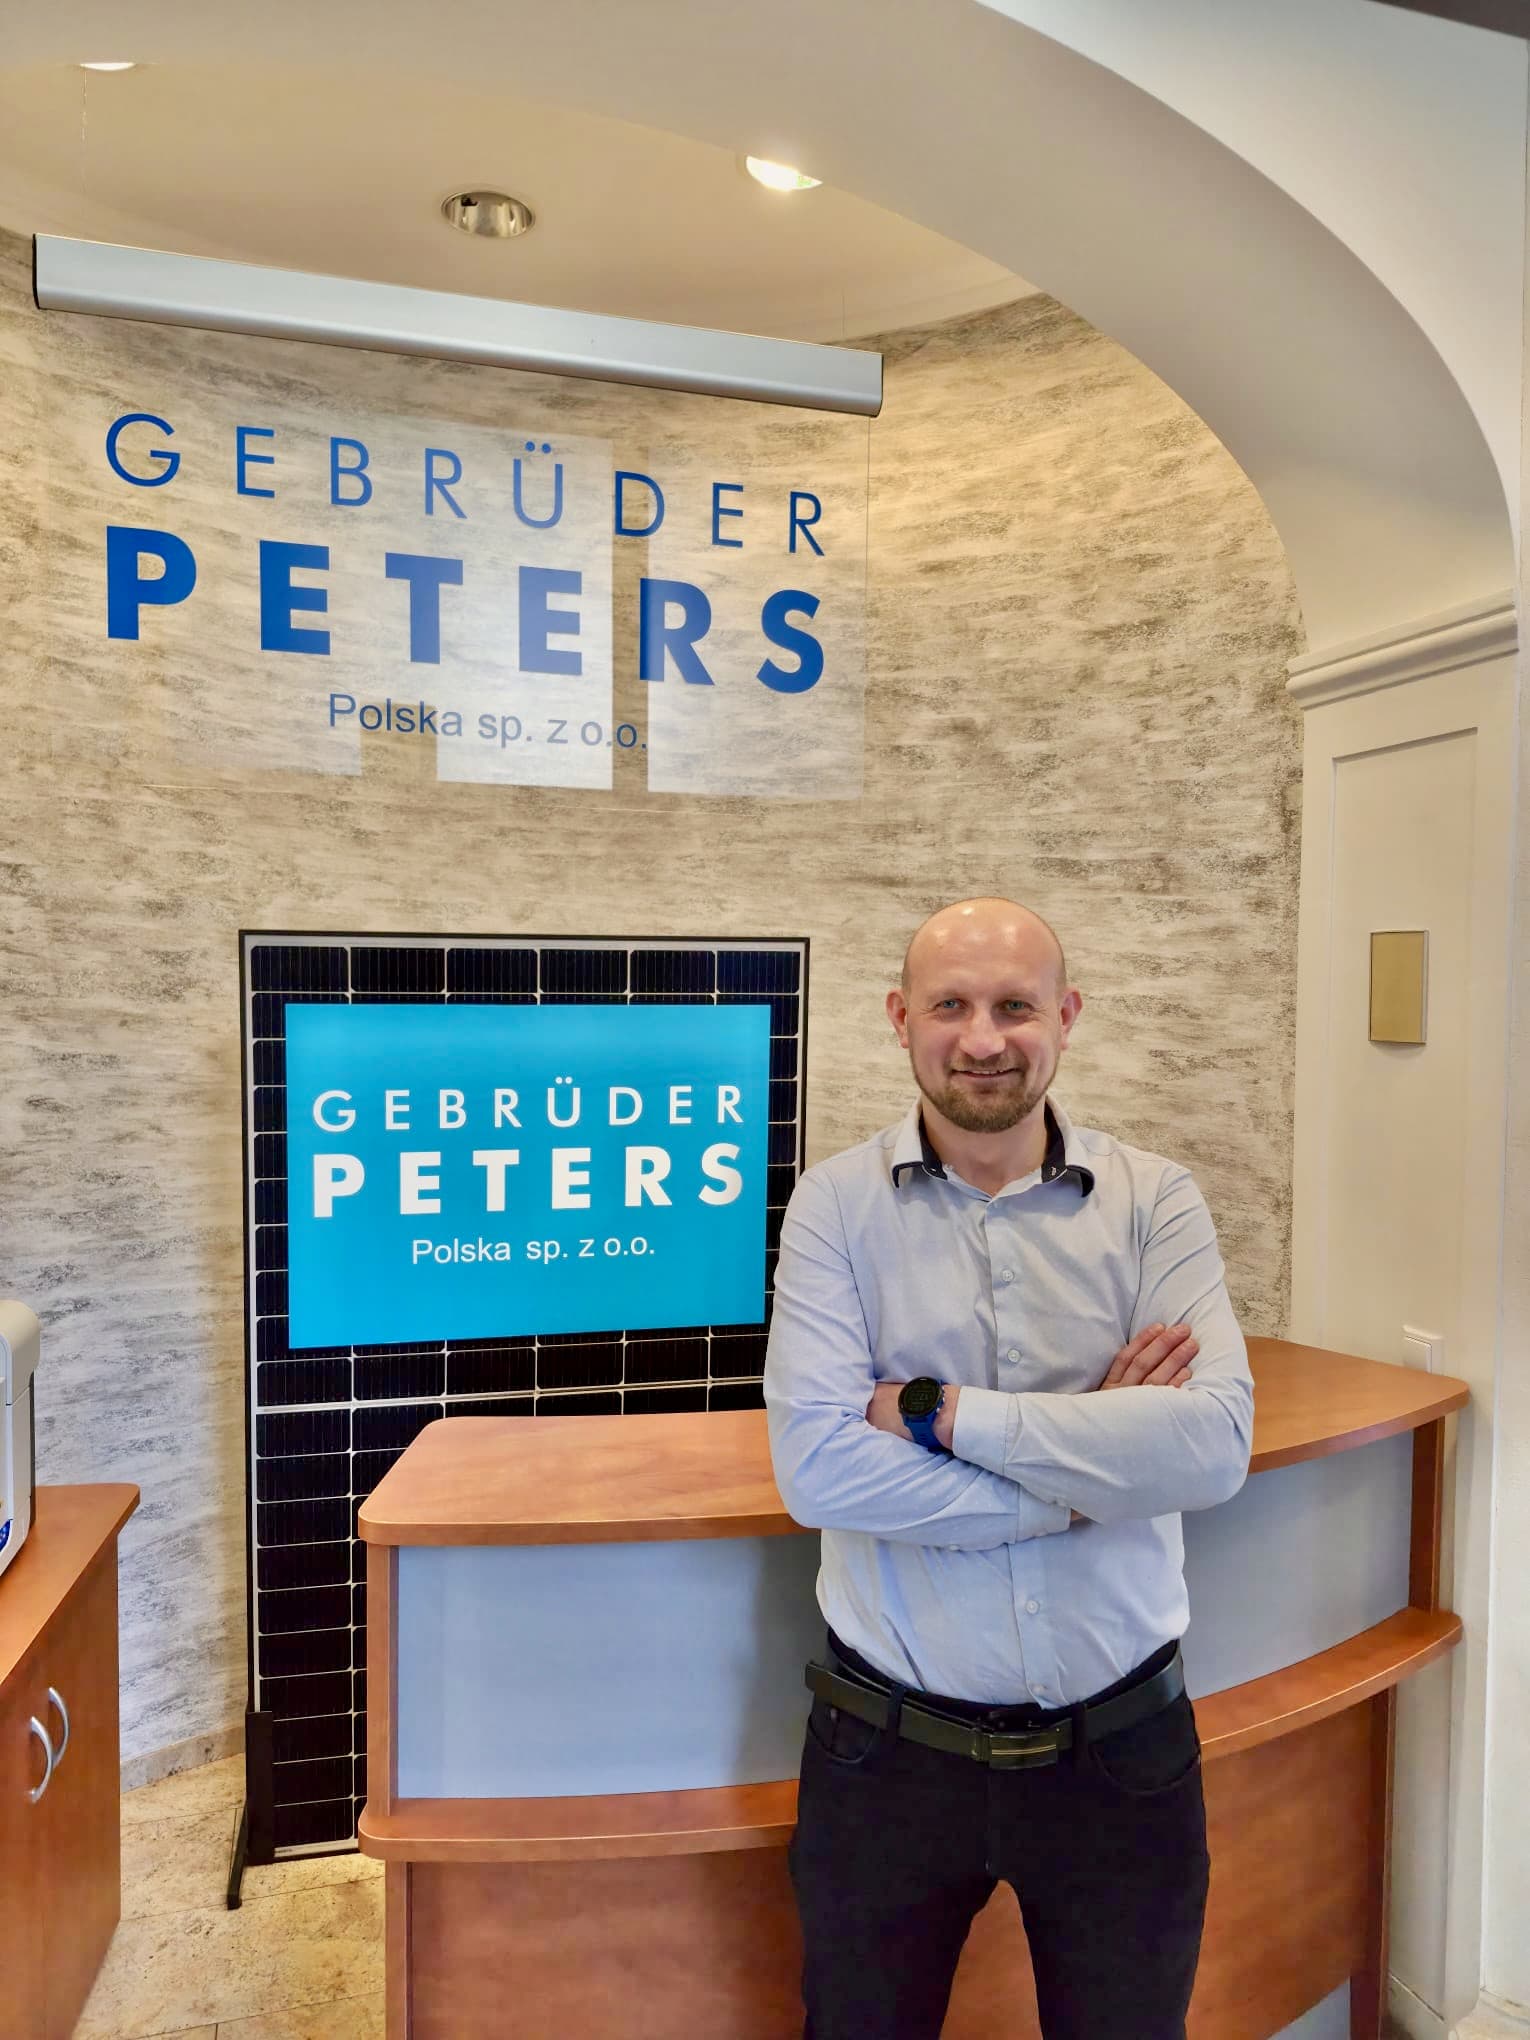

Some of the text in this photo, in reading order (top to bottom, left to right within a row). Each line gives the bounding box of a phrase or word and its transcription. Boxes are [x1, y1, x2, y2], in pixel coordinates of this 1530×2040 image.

[105, 413, 825, 557] GEBRÜDER
[105, 525, 825, 694] PETERS
[329, 693, 648, 749] Polska sp. z o.o.
[312, 1076, 744, 1133] GEBRÜDER
[312, 1143, 744, 1219] PETERS
[412, 1236, 655, 1265] Polska sp. z o.o.
